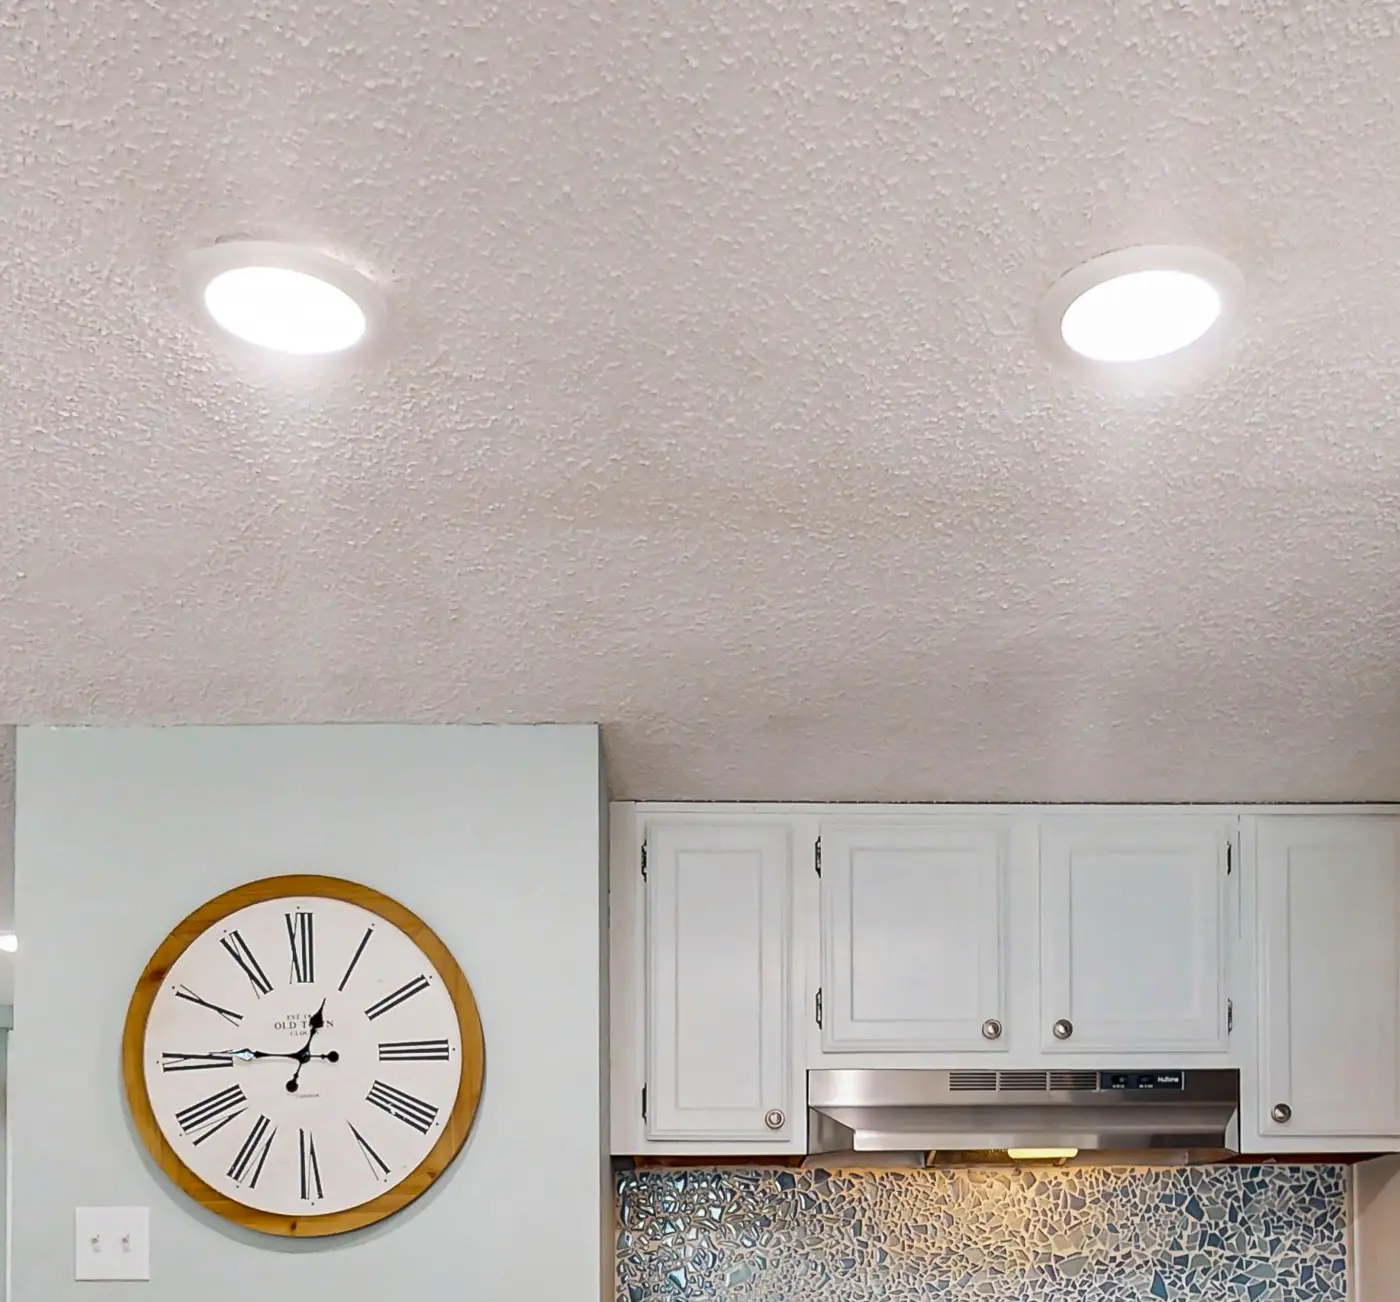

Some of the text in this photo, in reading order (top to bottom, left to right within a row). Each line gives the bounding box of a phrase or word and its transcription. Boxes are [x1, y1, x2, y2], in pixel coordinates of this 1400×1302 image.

[220, 929, 274, 999] XI
[285, 912, 314, 984] XII
[175, 984, 244, 1027] X
[274, 1021, 297, 1030] OLD
[364, 974, 431, 1021] II
[162, 1050, 235, 1072] IX
[378, 1039, 449, 1061] III
[175, 1084, 249, 1147] VIII
[365, 1080, 439, 1135] IIII
[226, 1114, 279, 1189] VII
[299, 1128, 324, 1200] VI
[346, 1119, 391, 1181] V
